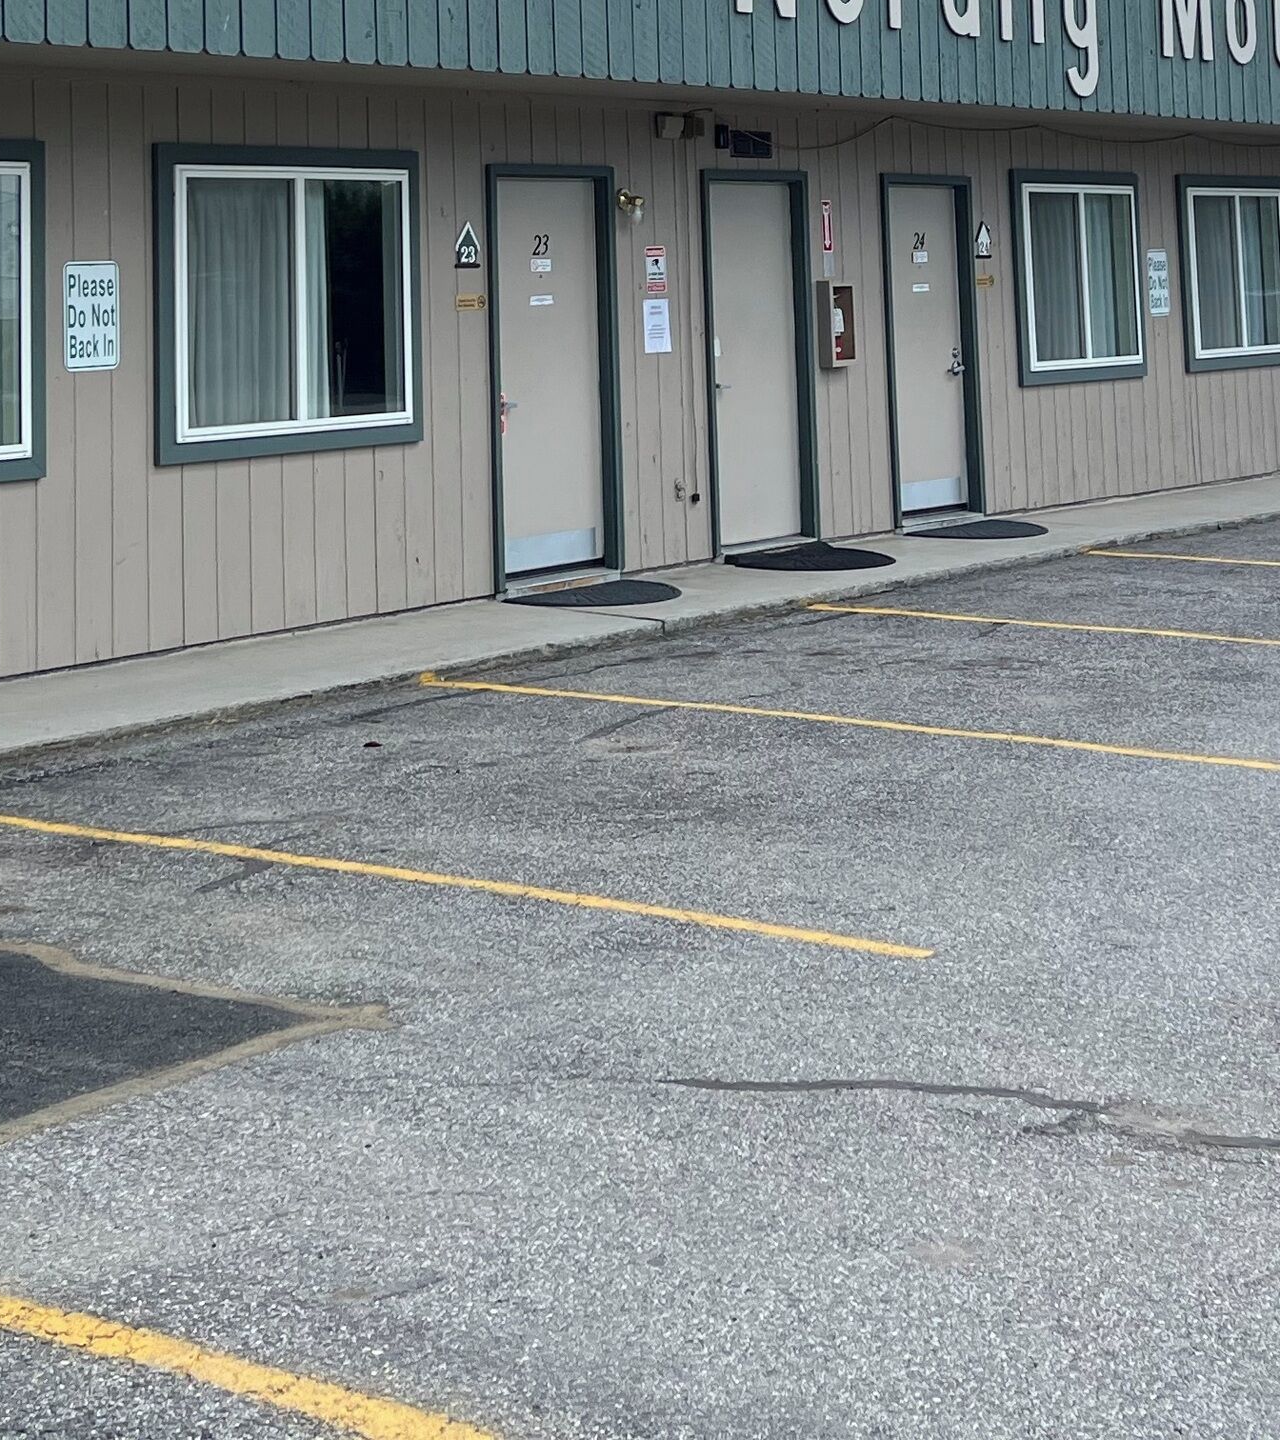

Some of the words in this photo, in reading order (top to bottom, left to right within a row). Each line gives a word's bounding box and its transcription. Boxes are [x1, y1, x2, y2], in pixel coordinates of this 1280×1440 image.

[531, 233, 550, 257] 23
[912, 231, 926, 250] 24
[460, 245, 477, 264] 23
[67, 273, 115, 298] Please
[67, 303, 87, 329] Do
[91, 302, 116, 328] Not
[69, 333, 100, 359] Back
[103, 332, 115, 358] In
